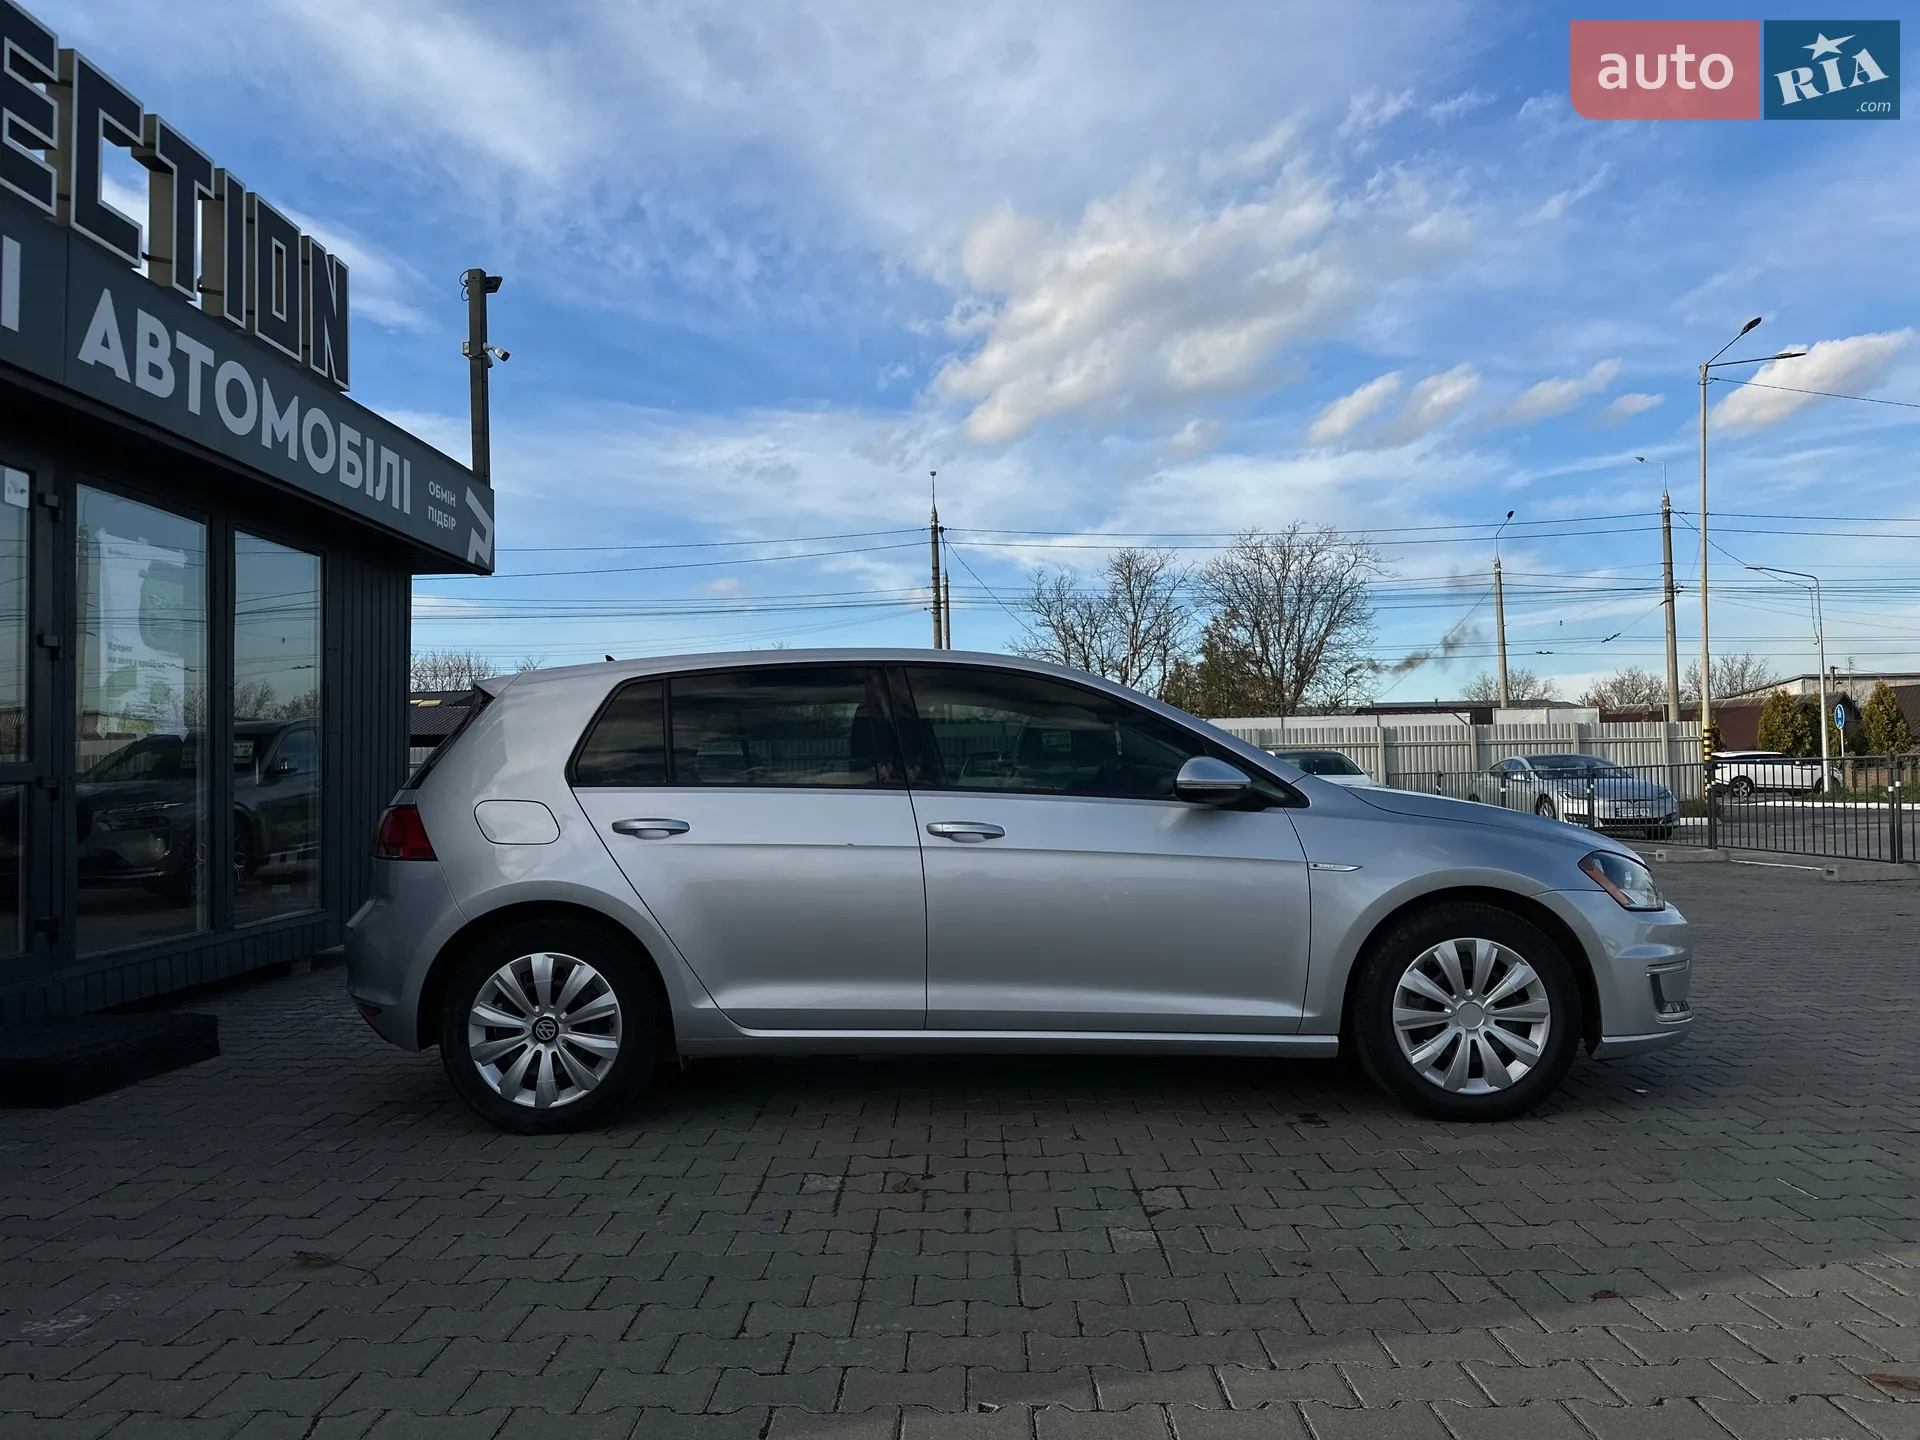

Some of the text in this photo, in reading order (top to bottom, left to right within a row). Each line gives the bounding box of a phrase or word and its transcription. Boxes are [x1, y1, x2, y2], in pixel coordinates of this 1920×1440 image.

[77, 287, 412, 516] АВТОМОБІЛІ
[428, 480, 456, 507] ОБМІН
[428, 505, 456, 531] ПІДБІР
